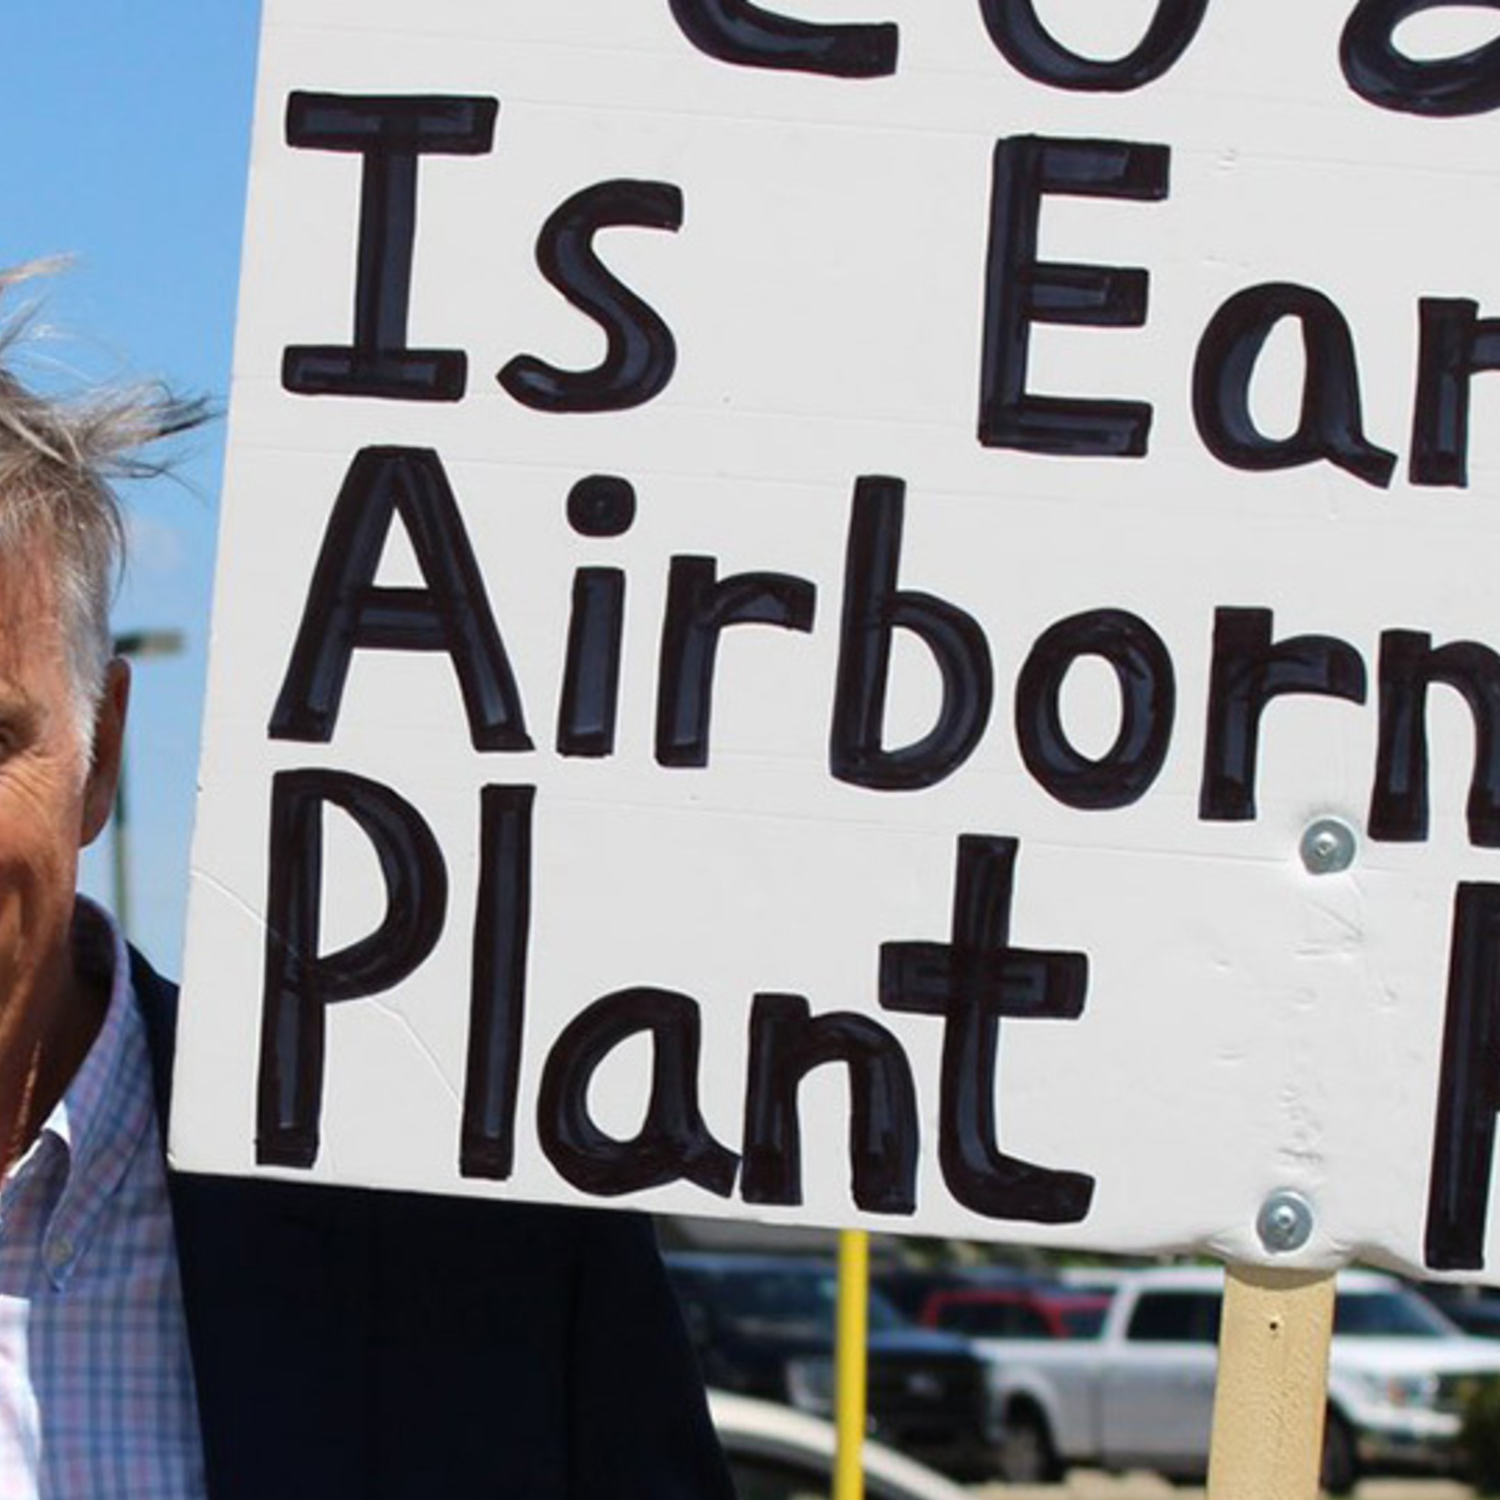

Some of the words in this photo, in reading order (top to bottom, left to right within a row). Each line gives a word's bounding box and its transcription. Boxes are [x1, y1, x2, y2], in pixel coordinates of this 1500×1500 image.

[282, 91, 684, 413] Is
[268, 446, 1500, 847] Airborn
[255, 768, 1095, 1222] Plant
